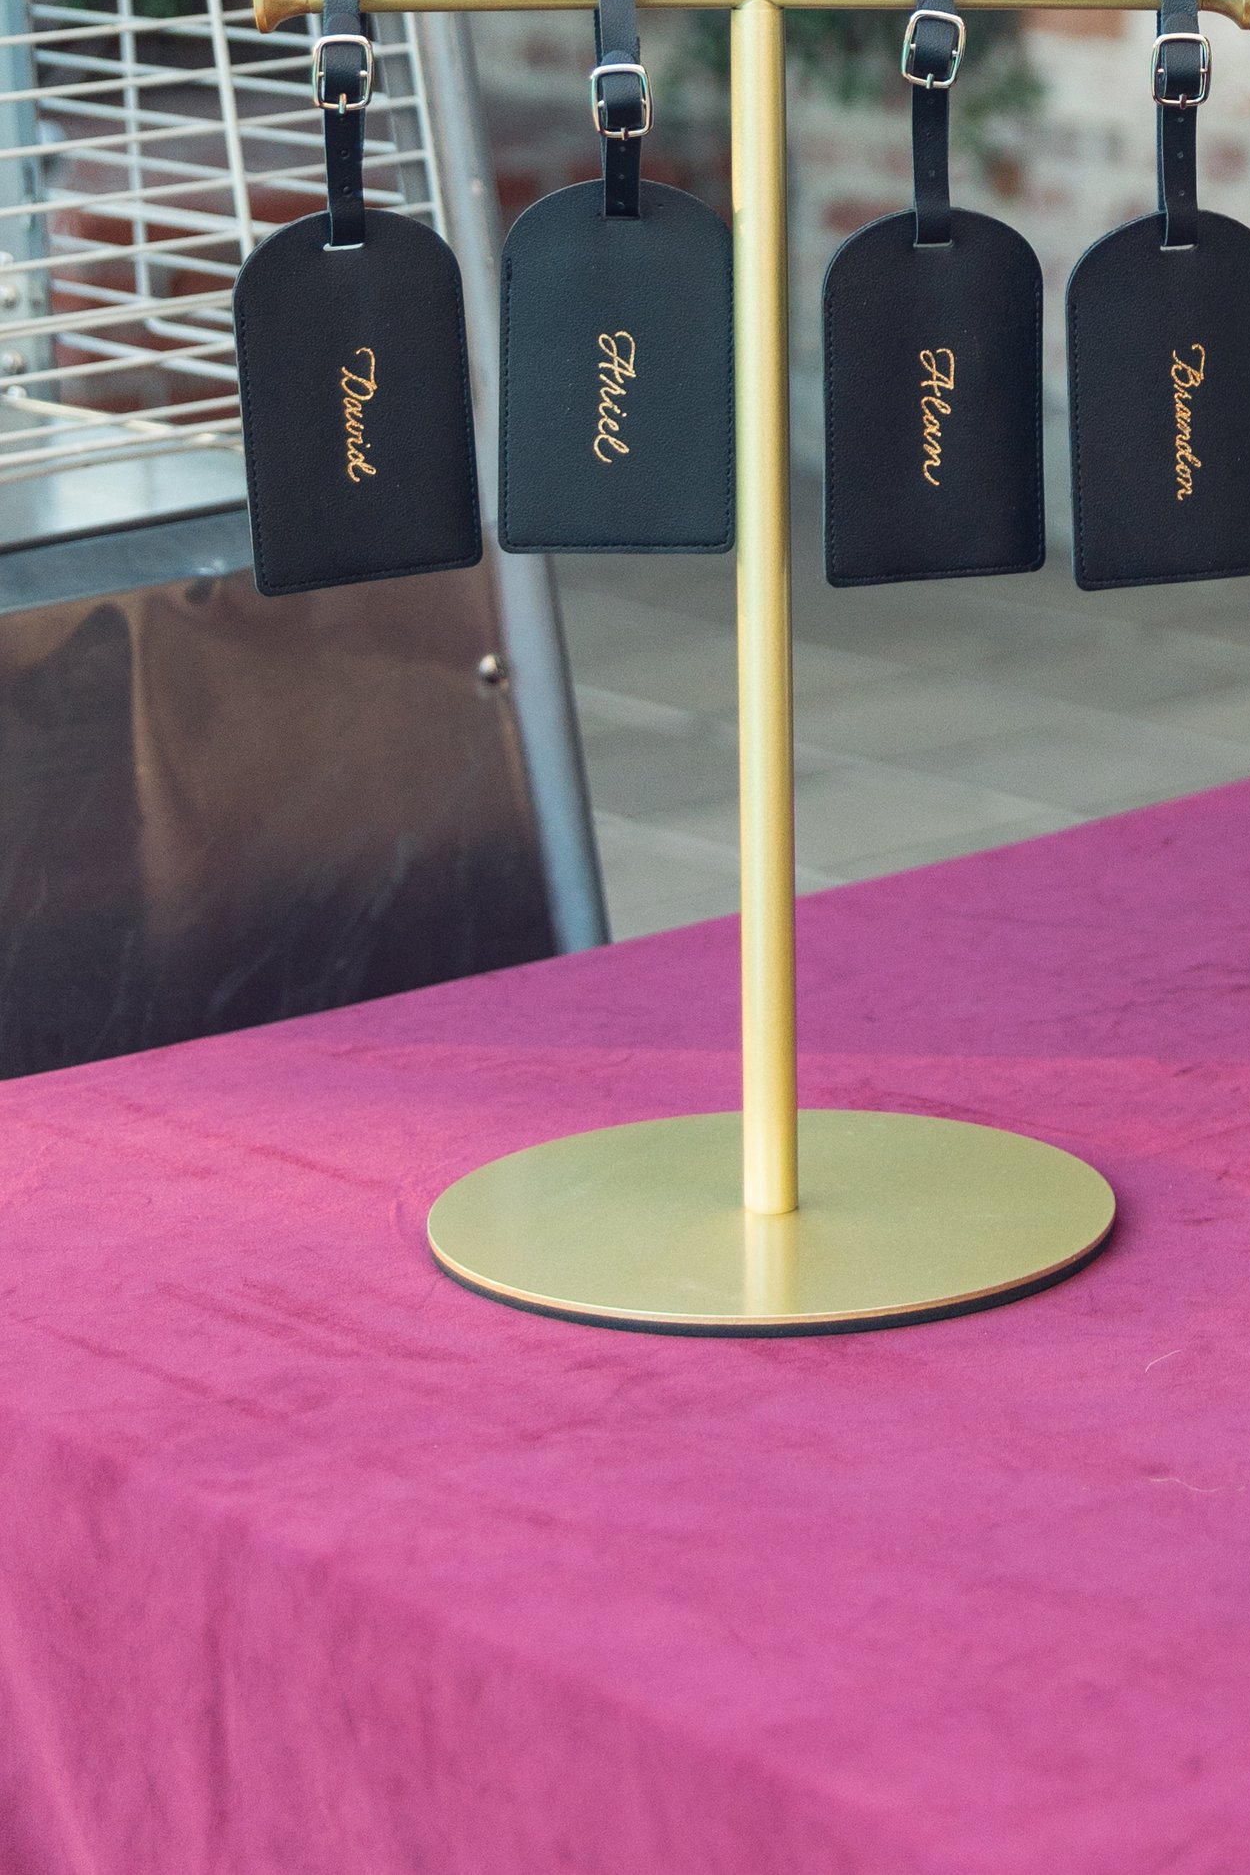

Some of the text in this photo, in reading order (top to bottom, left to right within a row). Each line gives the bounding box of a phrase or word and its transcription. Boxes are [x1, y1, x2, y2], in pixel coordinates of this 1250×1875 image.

[340, 346, 378, 483] David
[593, 330, 637, 463] Ariel
[919, 348, 955, 487] Alan
[1170, 343, 1206, 501] Brandon
